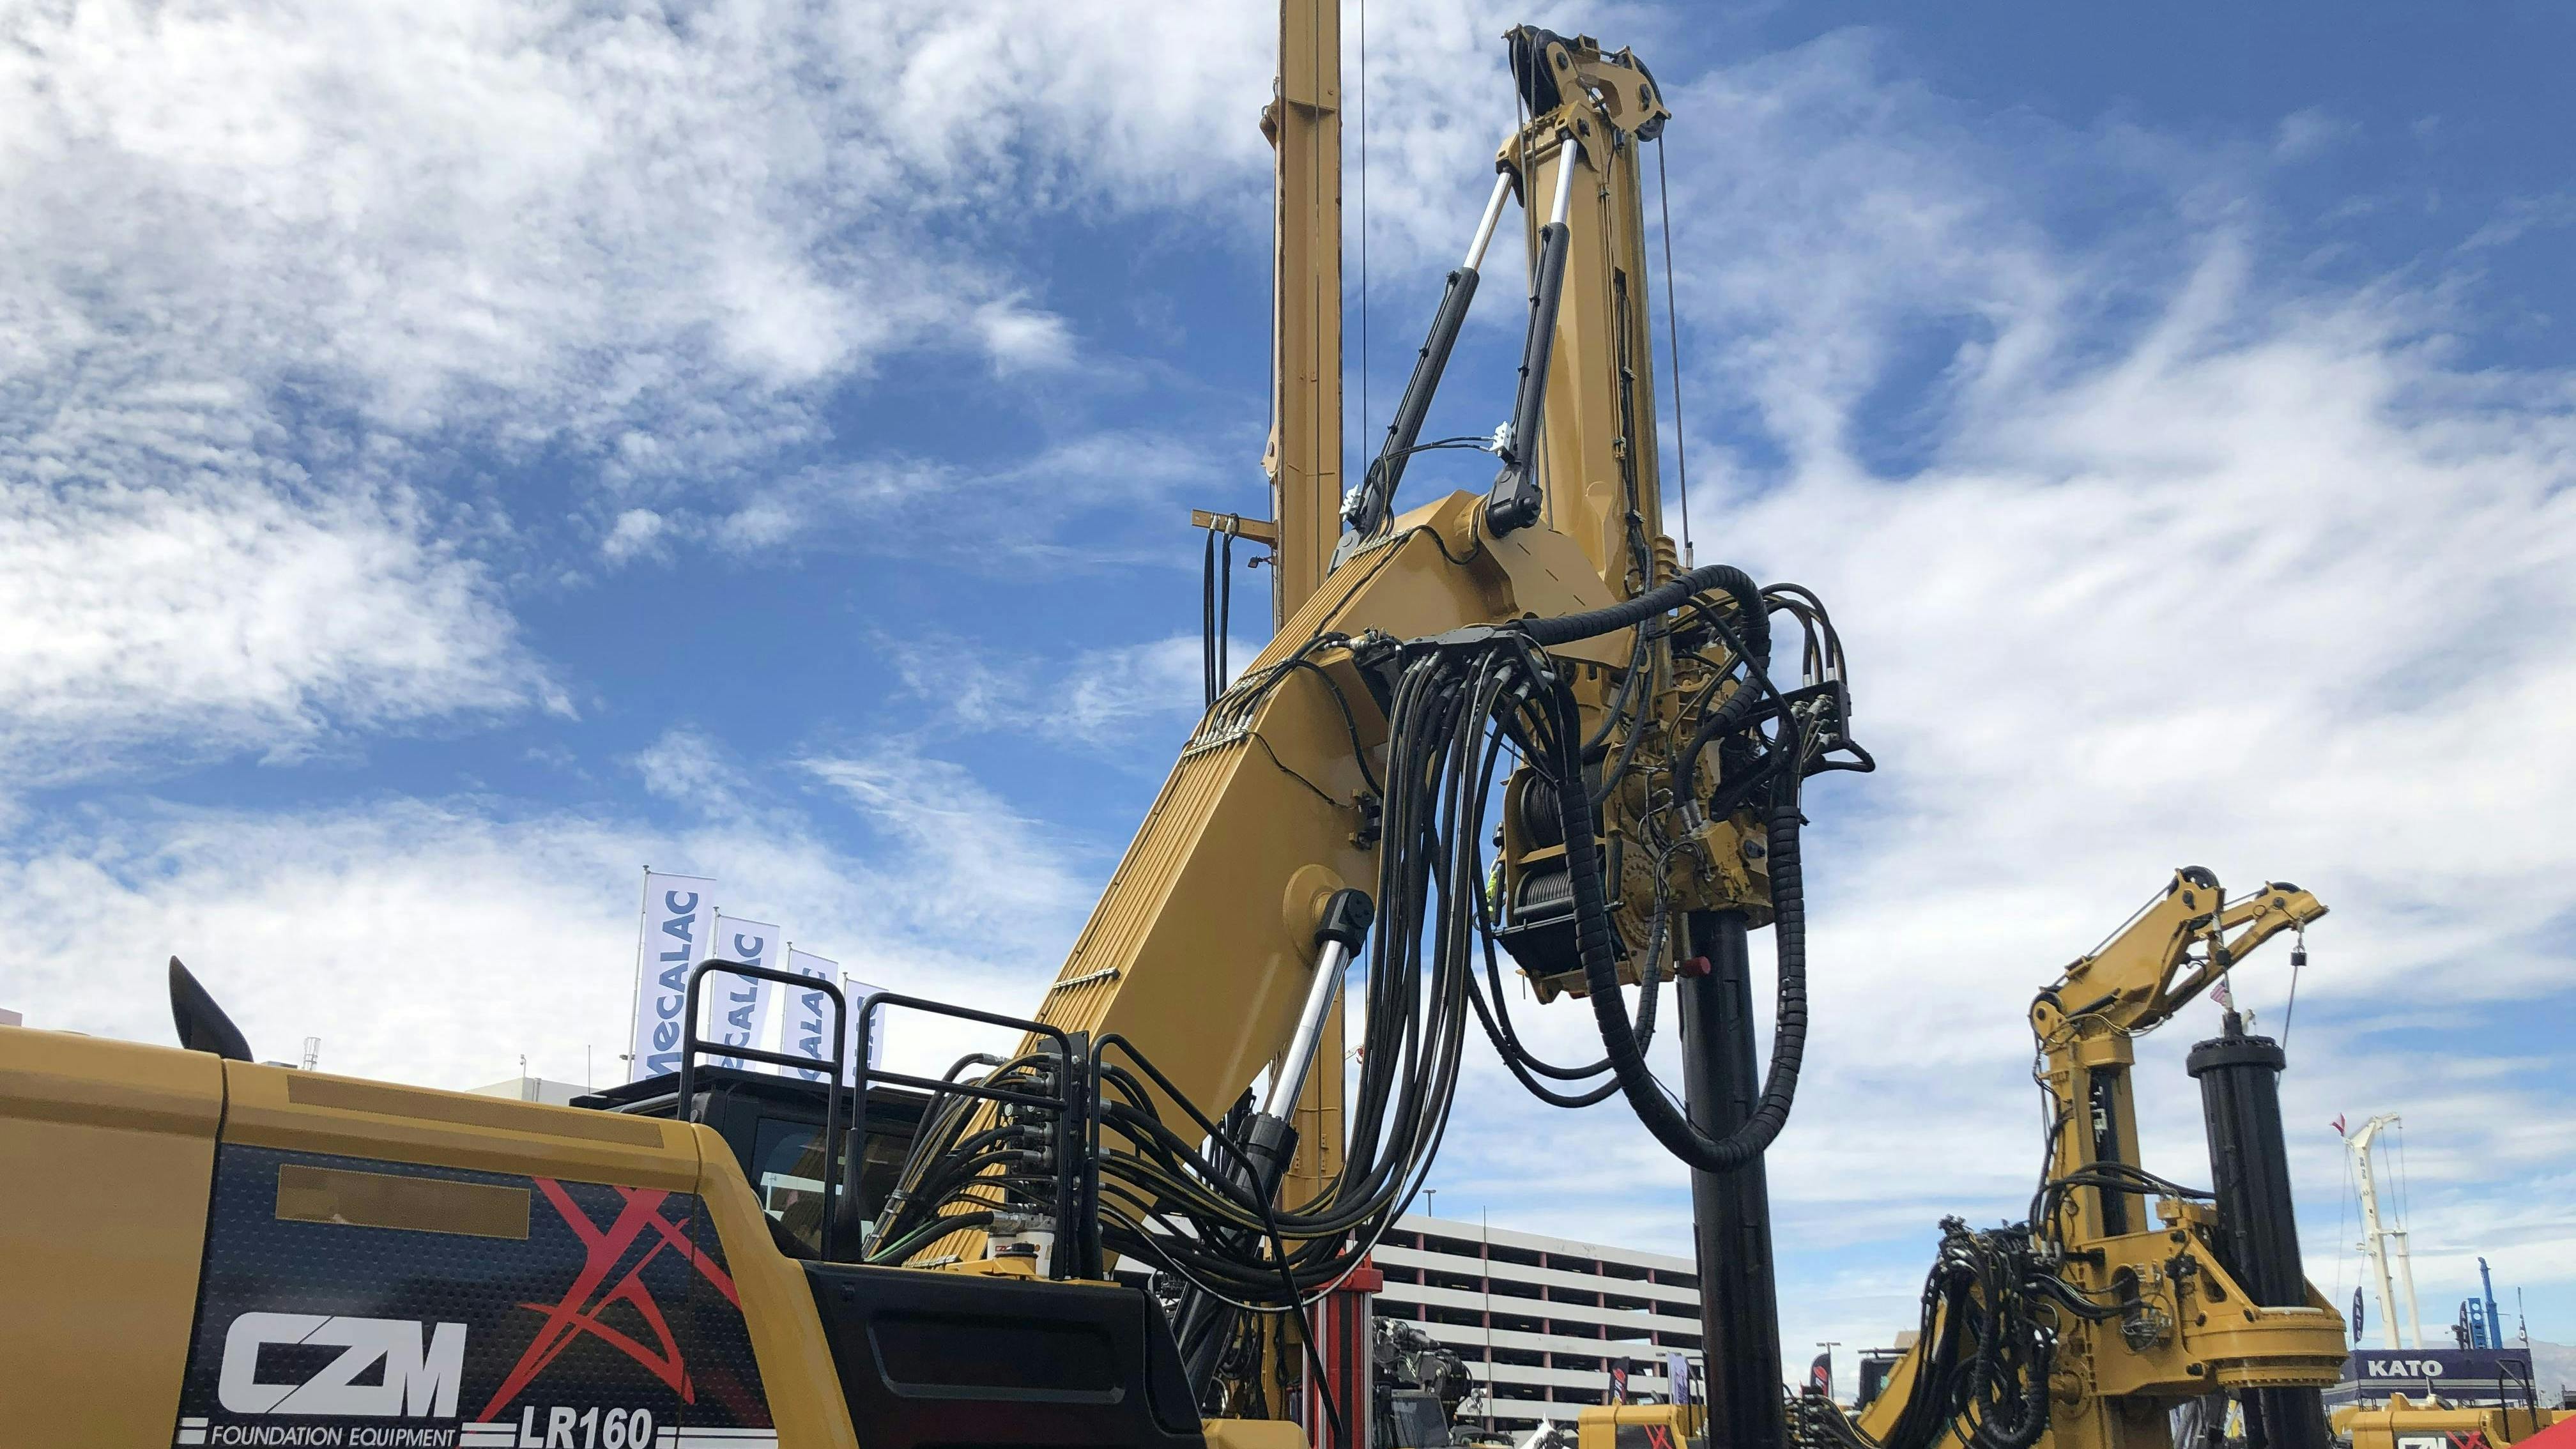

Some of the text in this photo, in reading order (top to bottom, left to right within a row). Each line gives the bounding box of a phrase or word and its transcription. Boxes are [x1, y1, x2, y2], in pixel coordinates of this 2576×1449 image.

[218, 1312, 467, 1418] CZM
[2368, 1360, 2442, 1377] KATO
[211, 1426, 456, 1447] FOUNDATION EQUIPMENT
[519, 1406, 652, 1449] LR160
